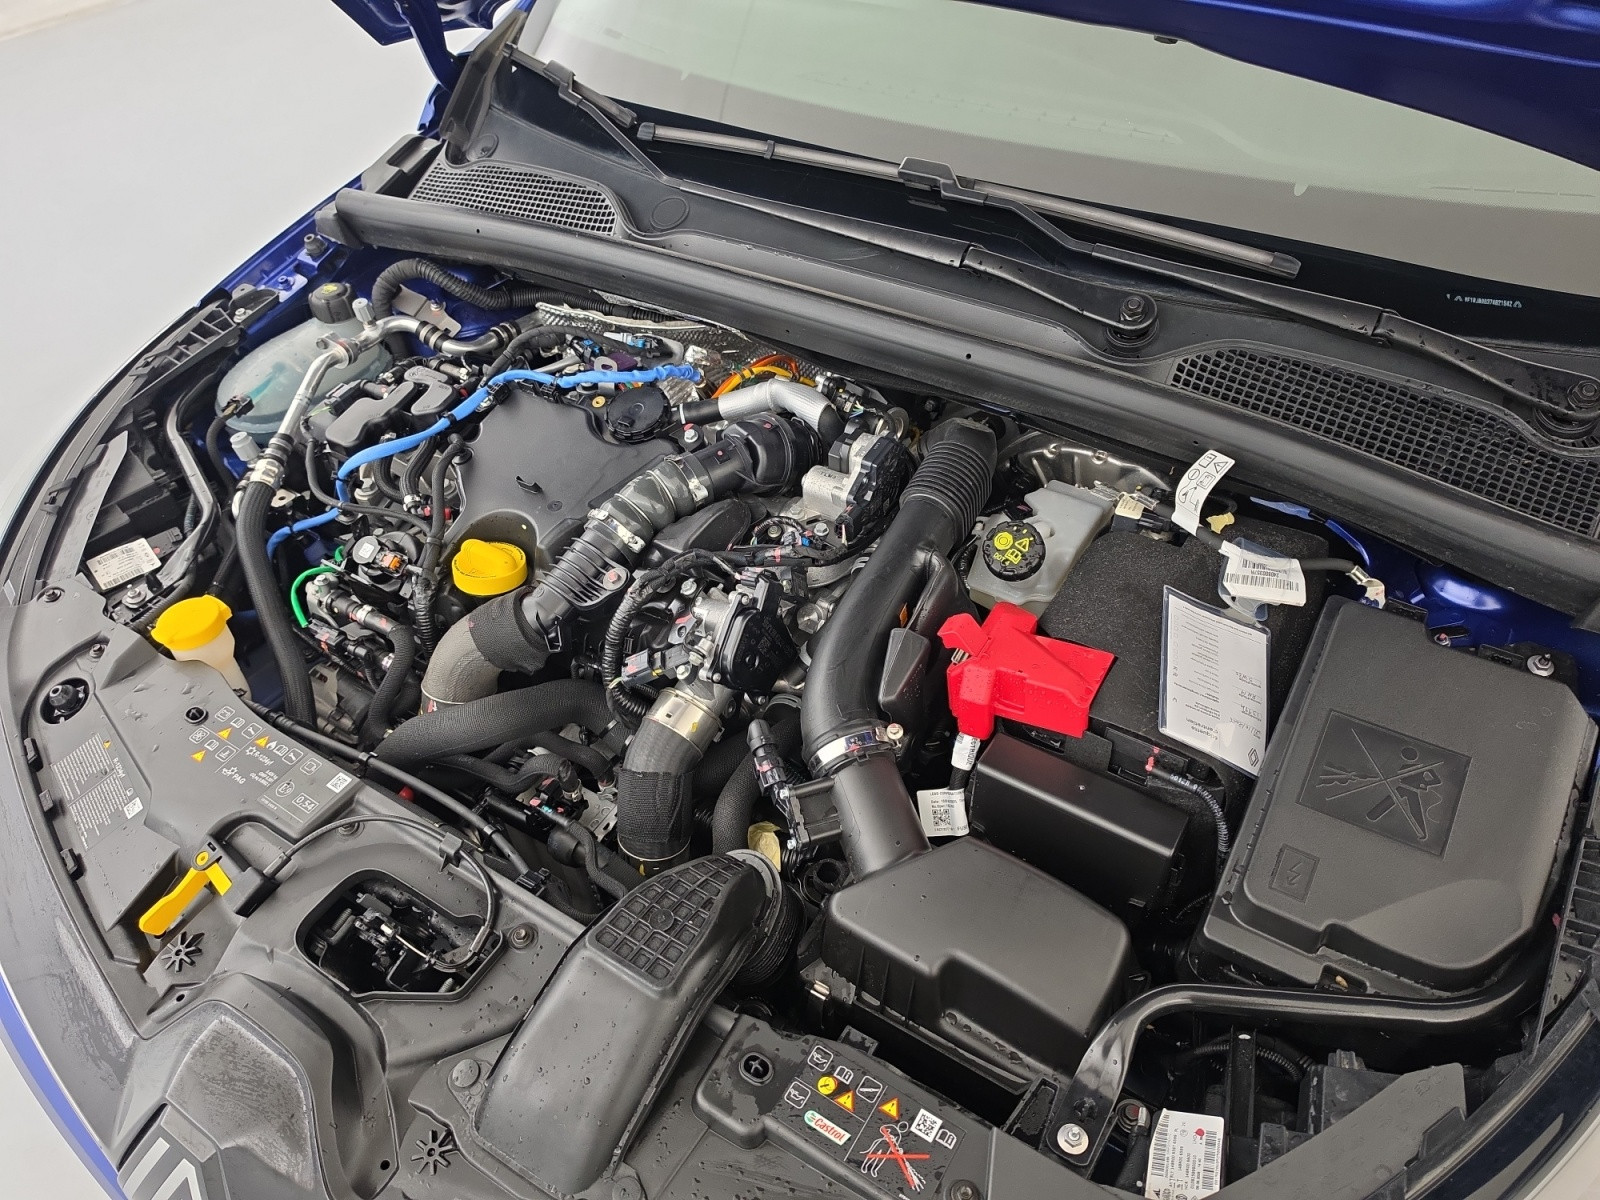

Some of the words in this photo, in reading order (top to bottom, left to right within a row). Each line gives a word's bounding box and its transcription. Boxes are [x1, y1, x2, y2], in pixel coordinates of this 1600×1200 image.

[993, 552, 1006, 562] DOT
[232, 773, 246, 785] PAG
[296, 796, 315, 811] 0,54
[814, 1118, 846, 1142] Castrol
